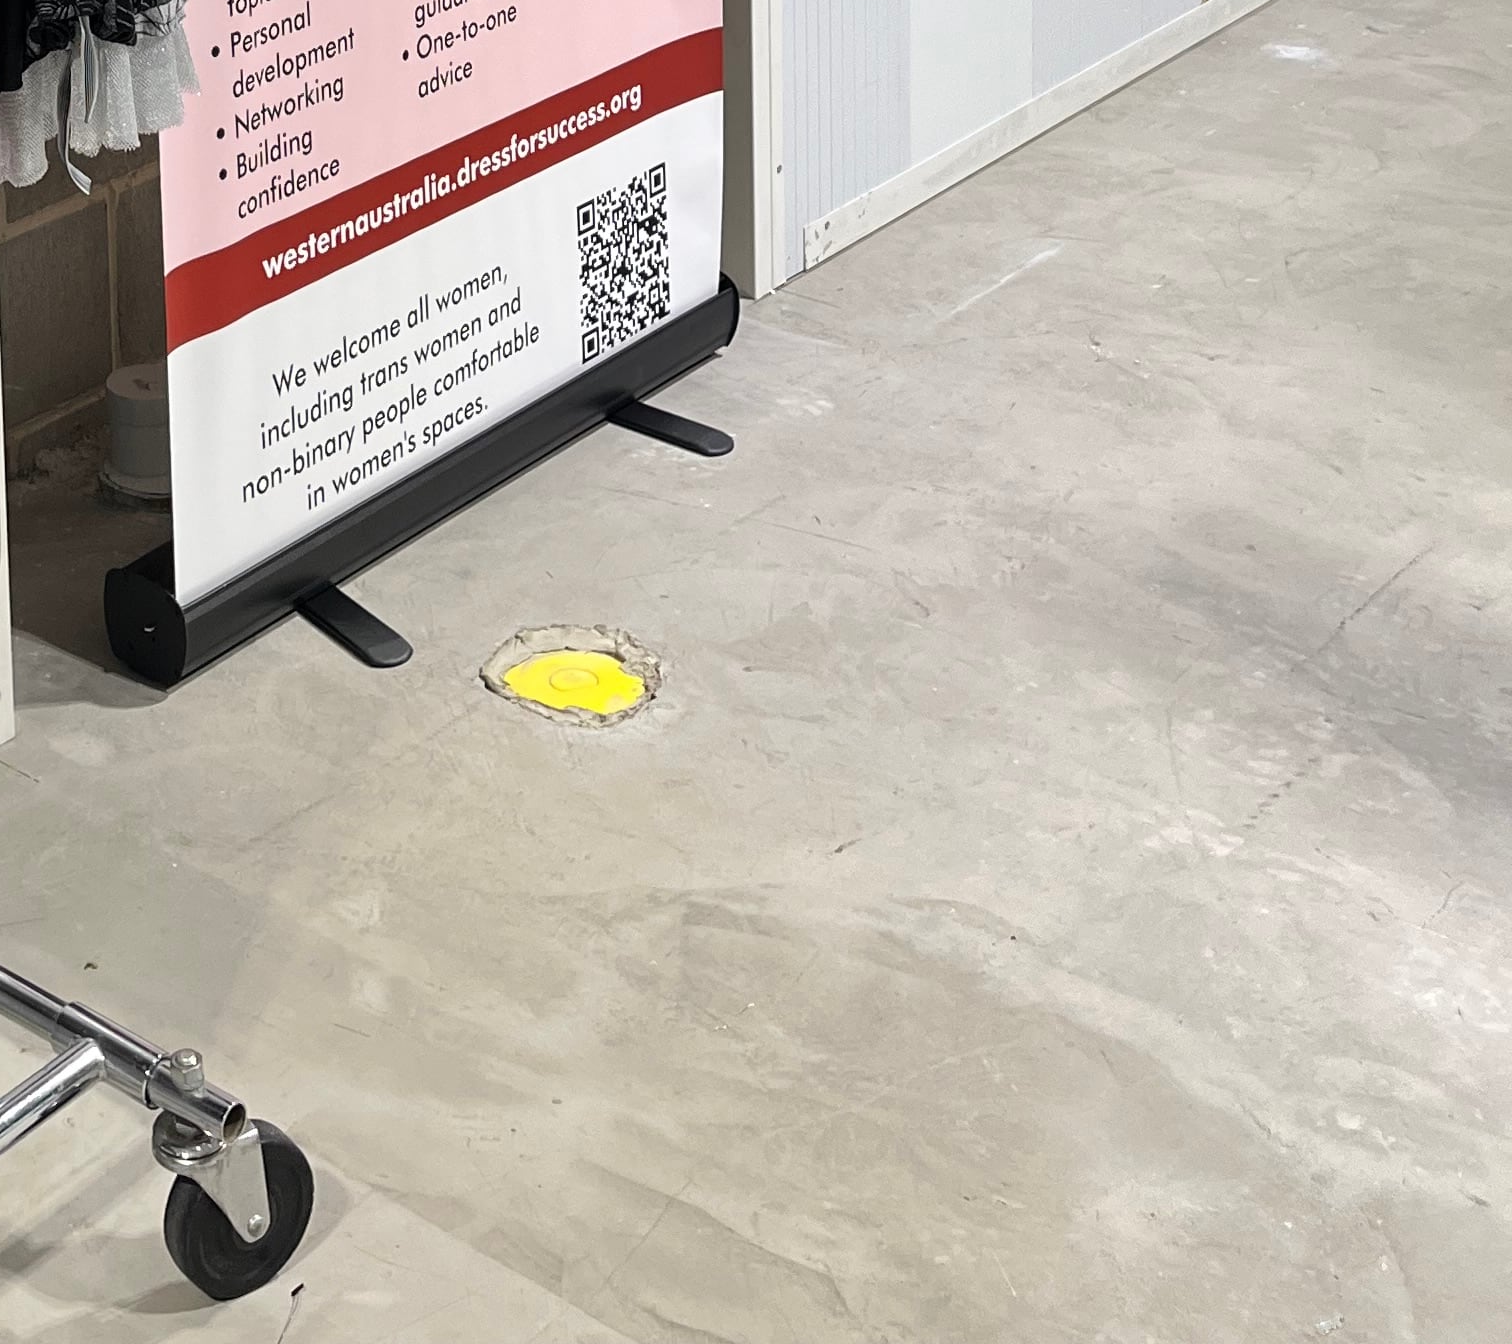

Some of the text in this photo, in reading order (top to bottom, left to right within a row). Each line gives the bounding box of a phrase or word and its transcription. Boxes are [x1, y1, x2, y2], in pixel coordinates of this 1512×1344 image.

[230, 0, 311, 58] Personal
[232, 27, 355, 99] development
[416, 5, 517, 60] One-to-one
[234, 76, 344, 140] Networking
[418, 61, 473, 99] advice
[236, 130, 313, 180] Building
[238, 158, 340, 220] confidence
[261, 84, 642, 279] westernaustralia.dressforsuccess.org
[271, 265, 508, 398] We welcome all women,
[260, 285, 521, 450] including trans women and
[242, 321, 540, 504] non-binary people comfortable
[306, 396, 489, 511] in women's spaces.
